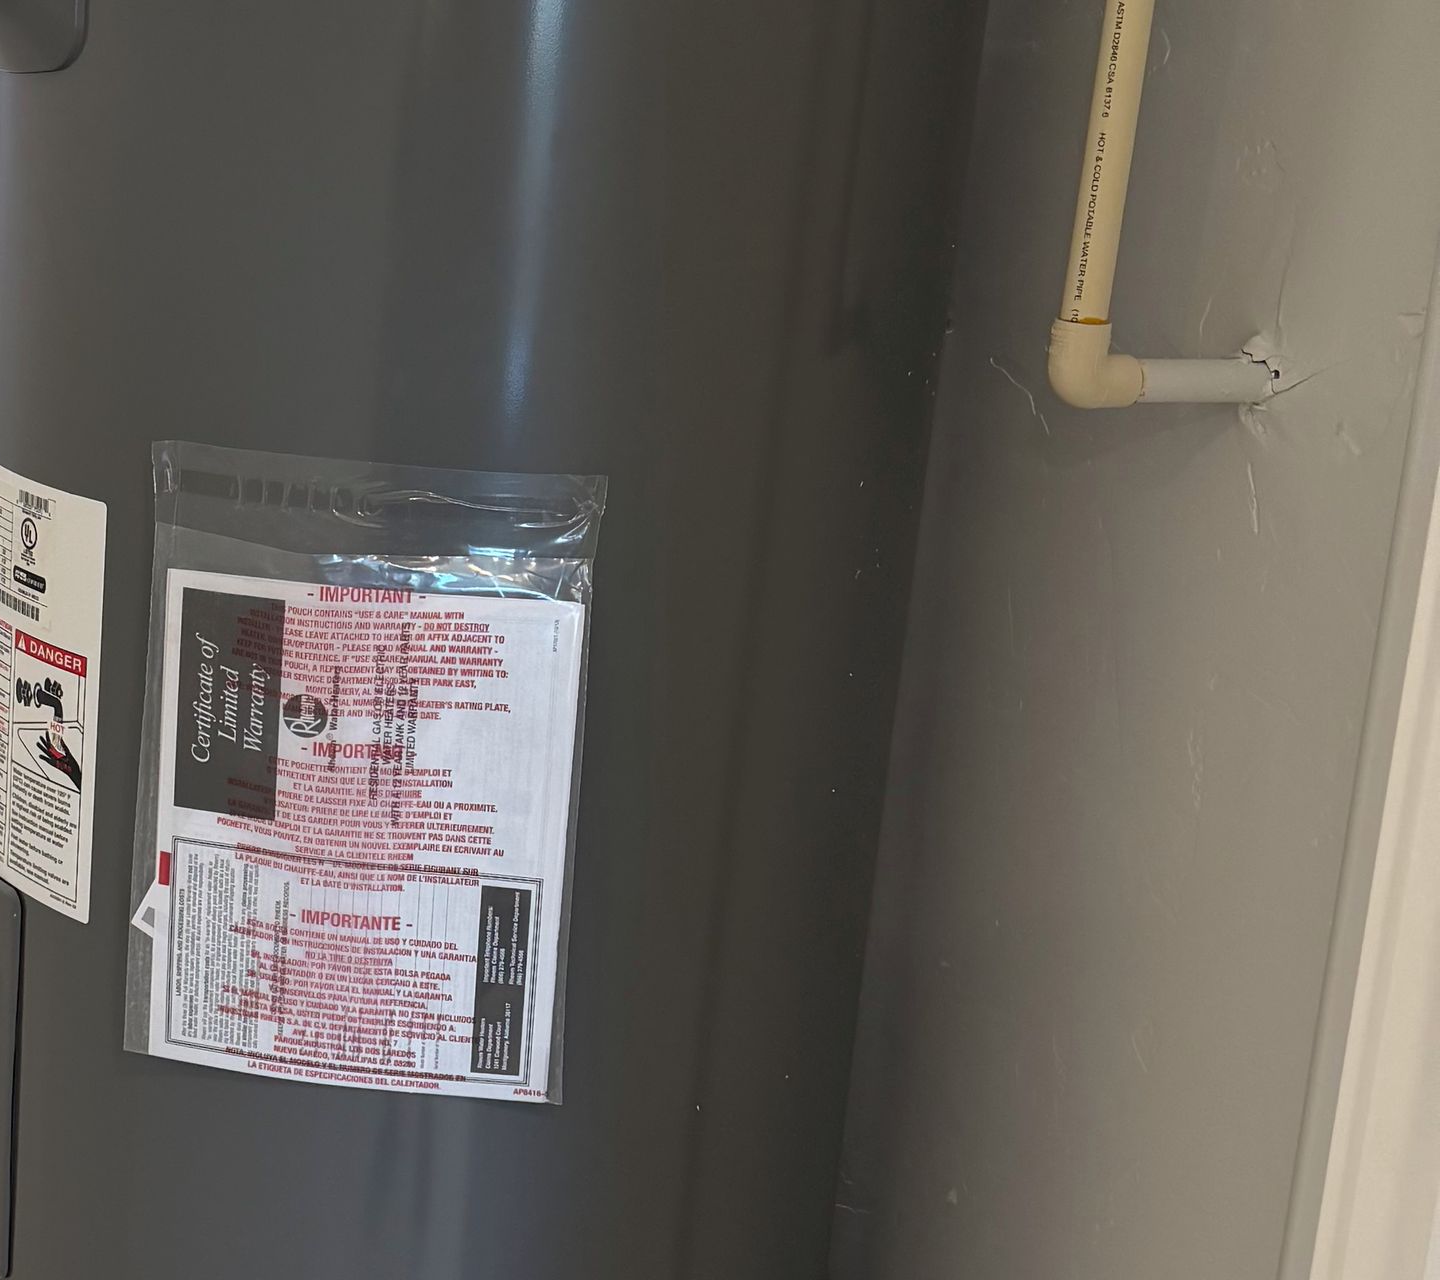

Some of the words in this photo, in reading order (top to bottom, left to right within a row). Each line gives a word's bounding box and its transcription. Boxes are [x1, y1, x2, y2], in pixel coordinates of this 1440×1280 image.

[1115, 1, 1126, 30] ASTM
[1105, 63, 1116, 84] CSA
[1097, 133, 1106, 152] HOT
[1091, 164, 1102, 192] COLD
[1084, 194, 1097, 239] POTABLE
[1077, 241, 1090, 277] WATER
[1073, 278, 1085, 300] PIPE
[319, 586, 413, 604] IMPORTANT
[288, 606, 312, 616] POUCH
[314, 608, 353, 618] CONTAINS
[410, 612, 443, 620] MANUAL
[444, 612, 464, 620] WITH
[423, 623, 435, 631] DO
[436, 623, 453, 631] NOT
[454, 624, 490, 632] DESTROY
[195, 632, 220, 659] of
[427, 634, 449, 642] AFFIX
[451, 634, 492, 644] ADJACENT
[494, 636, 505, 644] TO
[30, 641, 82, 672] DANGER
[432, 678, 453, 687] PARK
[460, 668, 494, 678] WRITING
[191, 663, 217, 763] Certificate
[218, 665, 240, 744] Limited
[243, 663, 271, 752] Warranty
[455, 702, 483, 711] RATING
[50, 722, 65, 734] HOT
[428, 833, 443, 841] PAS
[445, 834, 466, 843] DANS
[468, 836, 492, 845] CETTE
[301, 909, 401, 931] IMPORTANTE
[290, 929, 326, 940] CONTIENE
[248, 1060, 257, 1068] LA
[259, 1062, 292, 1075] ETIQUETA
[294, 1067, 303, 1076] DE
[305, 1068, 373, 1084] ESPECIFICACIONES
[375, 1076, 389, 1086] DEL
